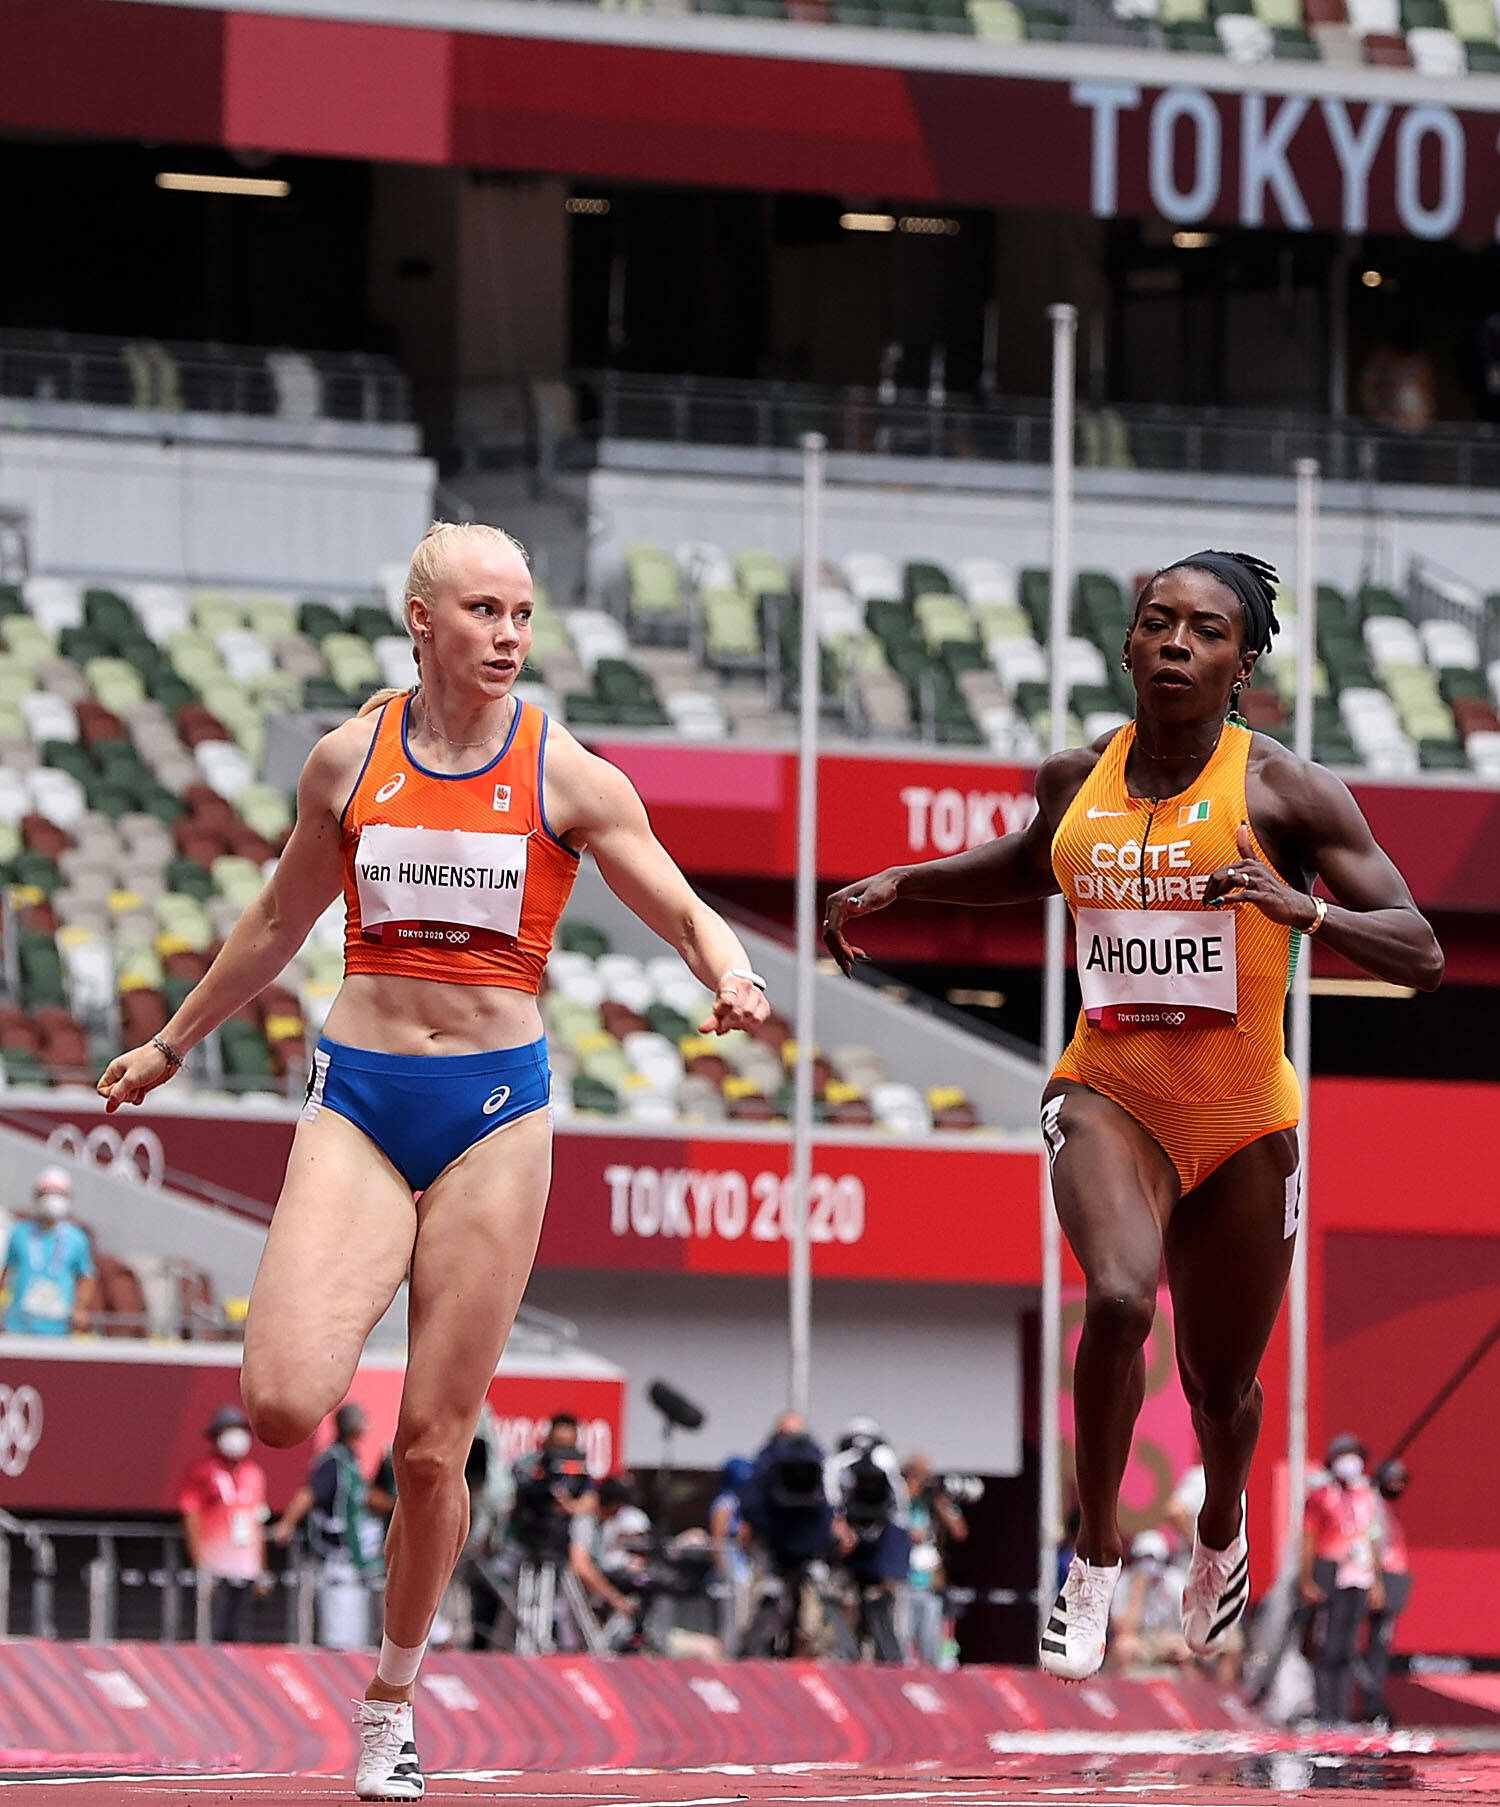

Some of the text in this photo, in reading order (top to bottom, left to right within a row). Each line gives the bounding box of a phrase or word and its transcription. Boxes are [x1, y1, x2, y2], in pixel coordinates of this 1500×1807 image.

[1072, 81, 1466, 241] TOKYO
[1091, 839, 1192, 871] CÔTE
[361, 862, 519, 889] van HUNENSTIJN
[398, 929, 444, 940] TOKYO 2020
[1086, 934, 1223, 975] AHOURE
[1117, 1013, 1160, 1022] TOKYO 2020
[603, 1164, 749, 1241] TOKYO
